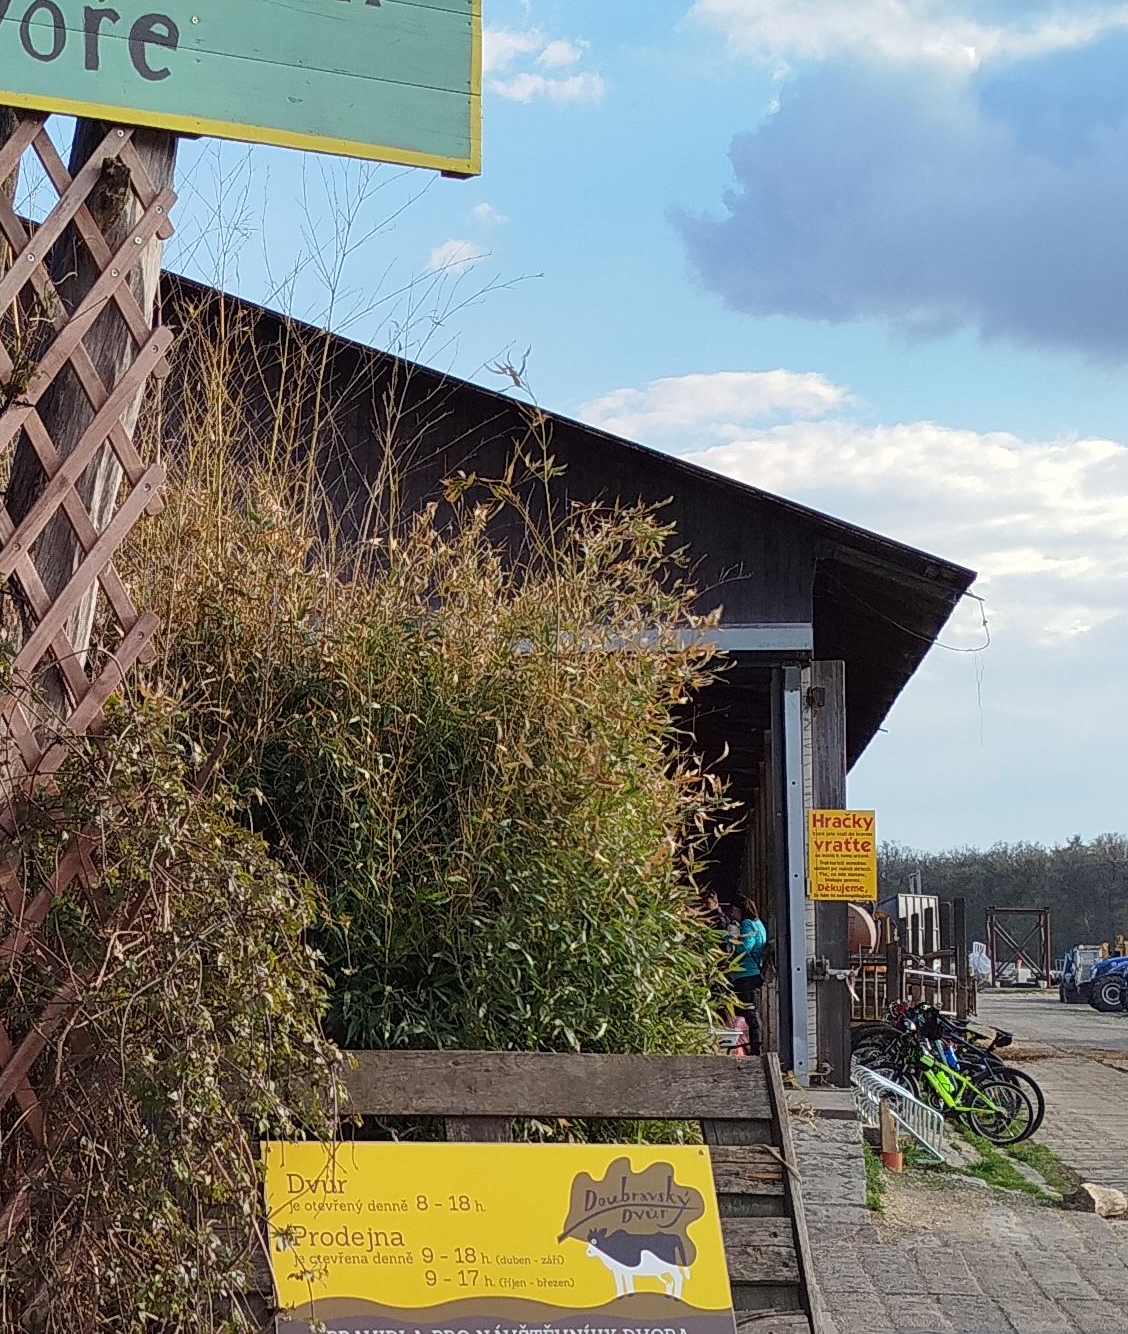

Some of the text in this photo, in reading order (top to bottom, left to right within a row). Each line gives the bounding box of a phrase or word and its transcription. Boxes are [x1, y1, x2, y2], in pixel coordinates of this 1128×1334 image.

[812, 813, 873, 831] Hračky
[814, 837, 871, 852] vraťte
[818, 884, 868, 894] Děkujeme,
[305, 1199, 363, 1215] otevřený
[368, 1199, 408, 1212] denně
[416, 1195, 429, 1211] 8
[448, 1195, 471, 1211] 18
[475, 1200, 487, 1212] h.
[583, 1176, 691, 1227] Doubravský
[293, 1226, 405, 1252] Prodejna
[309, 1251, 368, 1265] otevřena
[373, 1251, 413, 1264] denně
[421, 1247, 434, 1263] 9
[454, 1247, 476, 1263] 18
[481, 1252, 492, 1264] h.
[496, 1255, 534, 1266] (duben
[541, 1254, 565, 1266] září)
[425, 1270, 437, 1286] 9
[459, 1270, 479, 1286] 17
[484, 1275, 495, 1287] h.
[499, 1277, 527, 1289] (říjen
[536, 1277, 574, 1288] březen)
